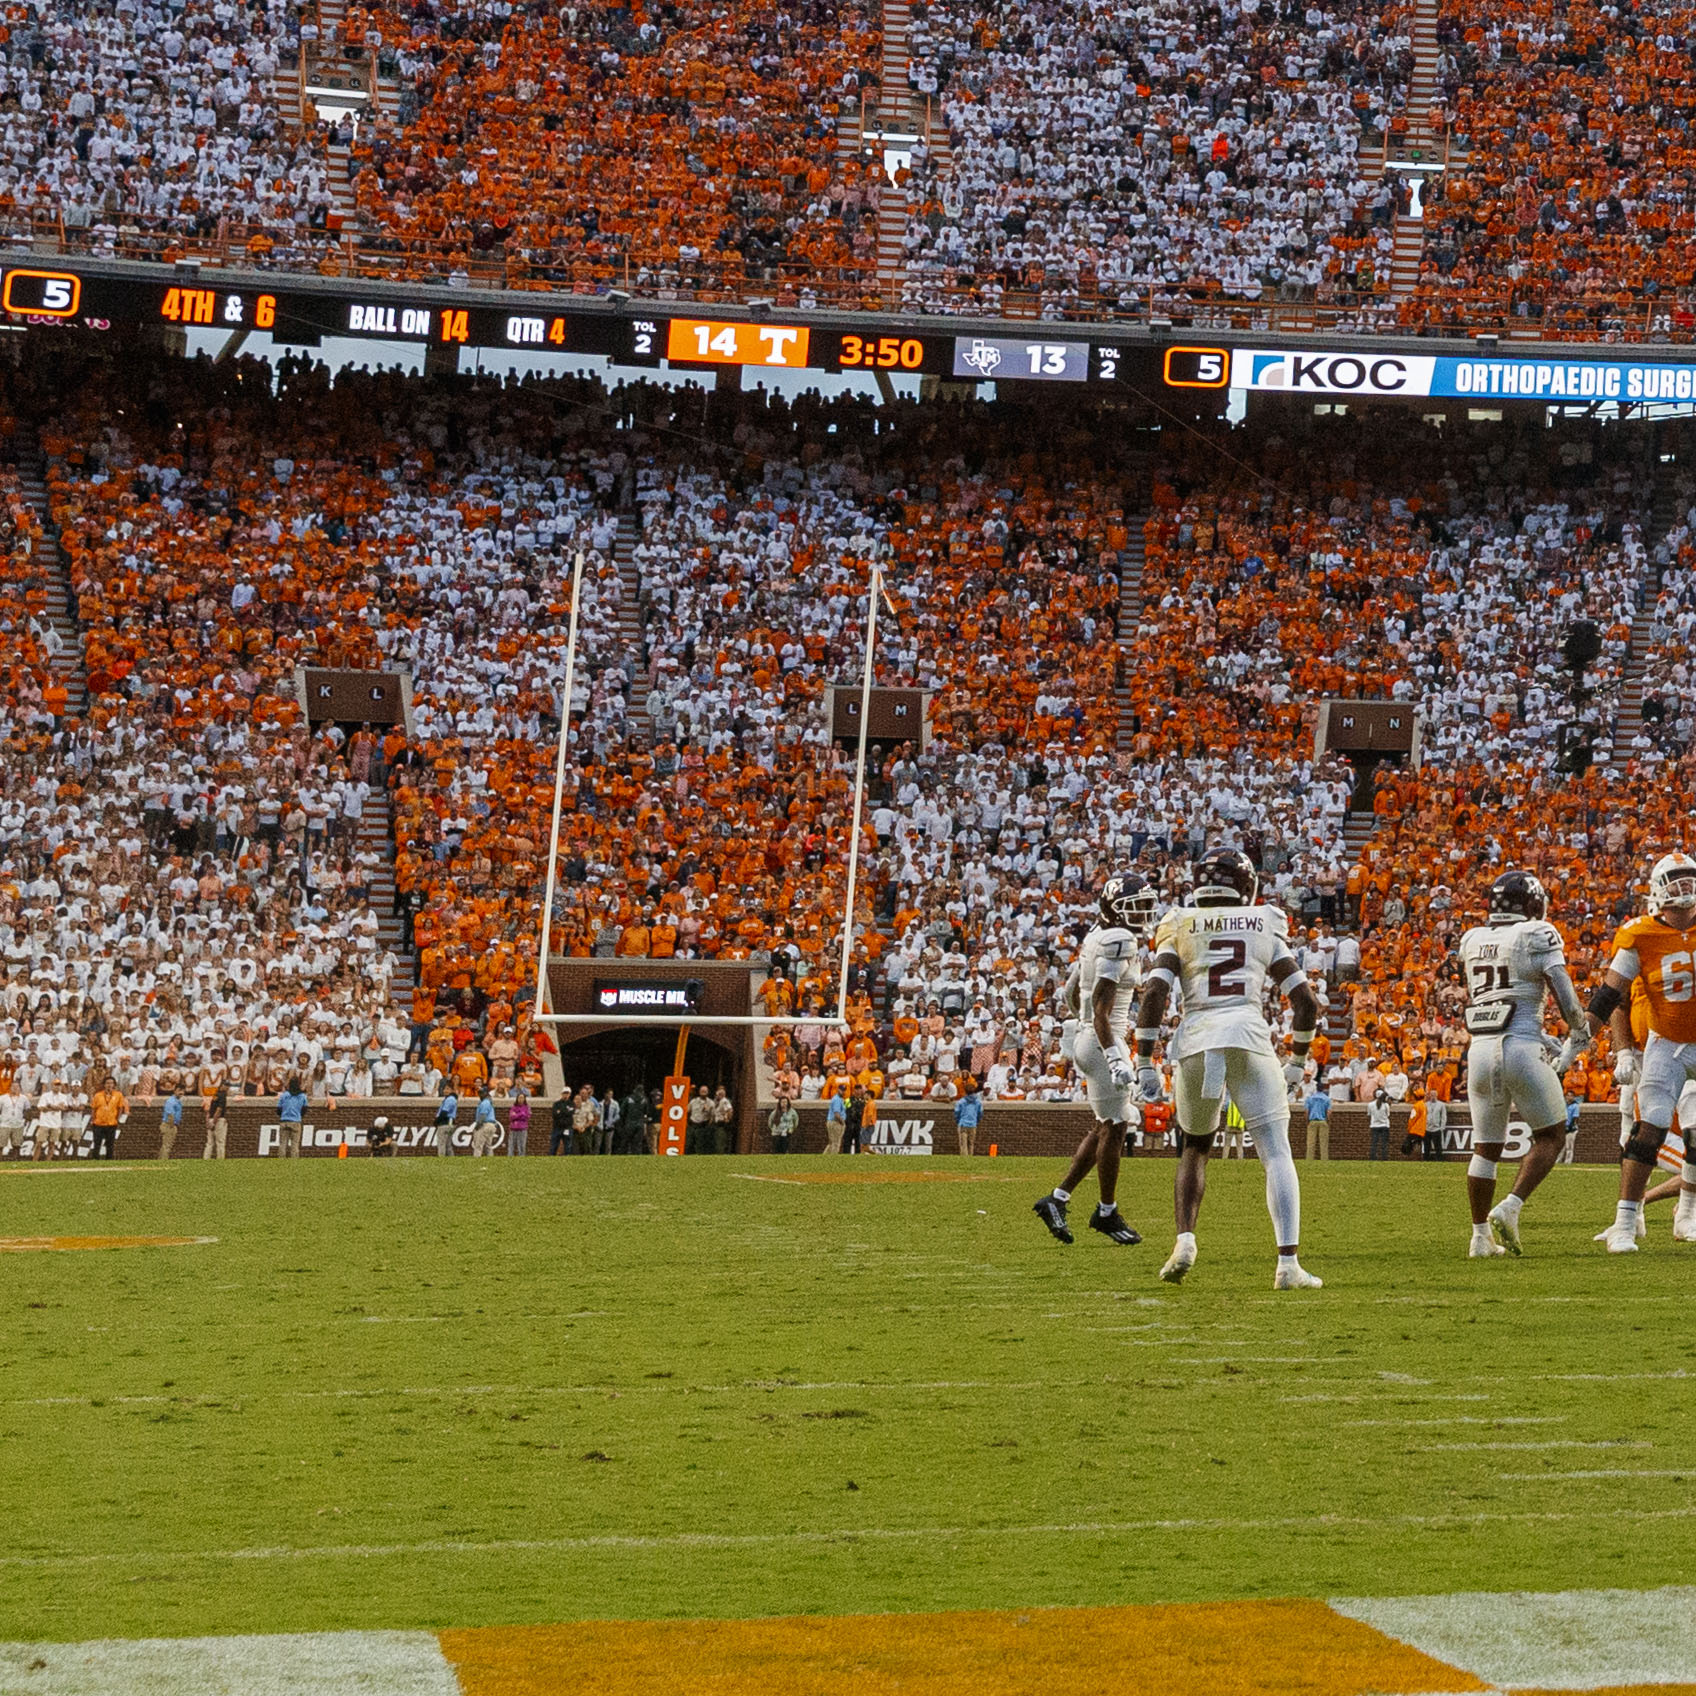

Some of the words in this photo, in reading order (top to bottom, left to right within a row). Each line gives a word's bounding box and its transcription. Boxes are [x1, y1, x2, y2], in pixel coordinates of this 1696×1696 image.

[43, 279, 71, 308] 5
[161, 288, 216, 324] 4TH
[224, 295, 243, 322] &
[255, 295, 276, 328] 6
[349, 304, 398, 332] BALL
[401, 309, 430, 336] ON
[441, 310, 470, 342] 14
[507, 317, 545, 343] QTR
[549, 319, 565, 344] 4
[633, 321, 657, 334] TOL
[634, 336, 652, 354] 2
[693, 325, 738, 357] 14
[759, 328, 797, 364] T
[839, 336, 924, 369] 3:50
[1098, 348, 1120, 359] TOL
[1026, 345, 1067, 375] 13
[1100, 360, 1115, 379] 2
[1197, 355, 1221, 381] 5
[1291, 357, 1407, 391] KOC
[1455, 363, 1620, 396] ORTHOPAEDIC
[320, 686, 330, 697] K
[373, 688, 382, 699] L
[849, 703, 857, 714] L
[895, 705, 907, 716] M
[1343, 717, 1354, 728] M
[1390, 719, 1400, 729] N
[1189, 919, 1199, 933] J.
[1204, 917, 1264, 932] MATHEWS
[1479, 944, 1501, 959] YORK
[1207, 939, 1246, 997] 2
[1472, 965, 1514, 998] 21
[619, 989, 665, 1004] MUSCLE
[665, 990, 694, 1007] MIL
[1472, 1010, 1500, 1022] DOUGLAS
[258, 1124, 368, 1155] plot
[1500, 1121, 1533, 1158] 8
